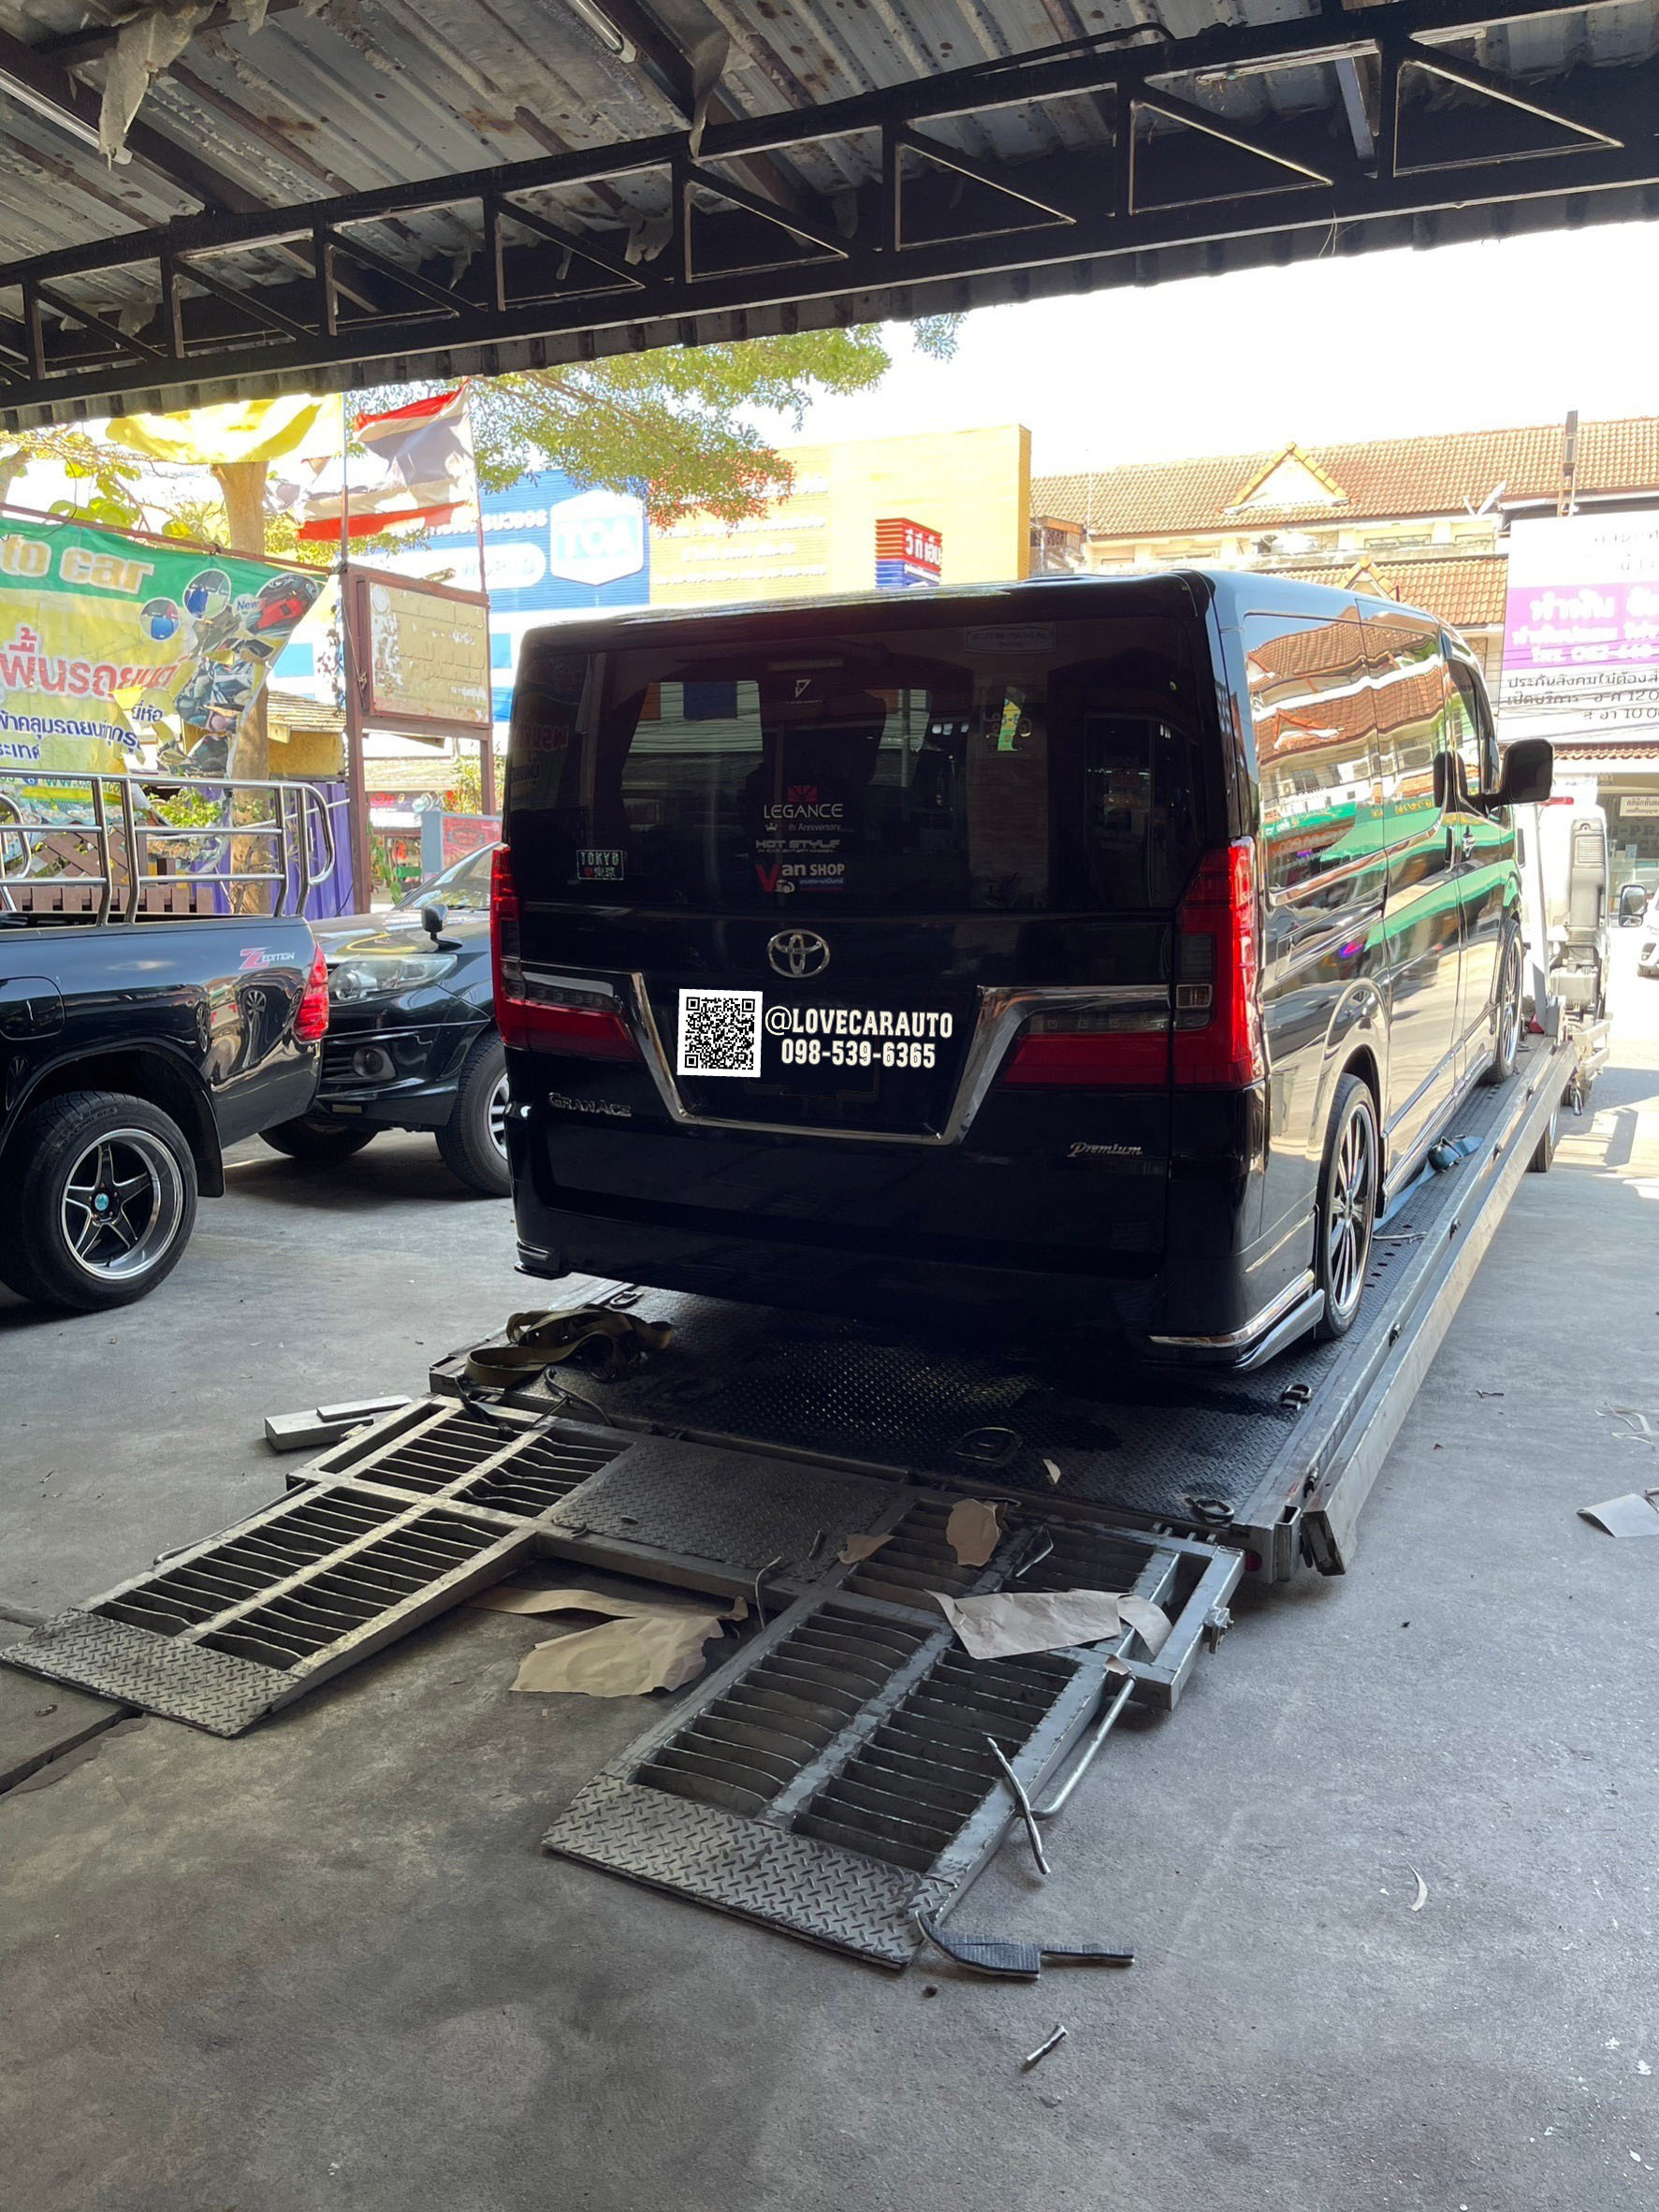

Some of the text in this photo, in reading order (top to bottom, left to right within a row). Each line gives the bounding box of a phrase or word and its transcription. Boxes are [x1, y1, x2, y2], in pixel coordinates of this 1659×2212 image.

[559, 519, 636, 560] TOA
[763, 803, 845, 820] LEGANCE
[755, 839, 786, 849] HOT
[580, 851, 619, 866] TOKYO
[809, 863, 846, 877] SHOP
[1067, 1142, 1142, 1157] Premium
